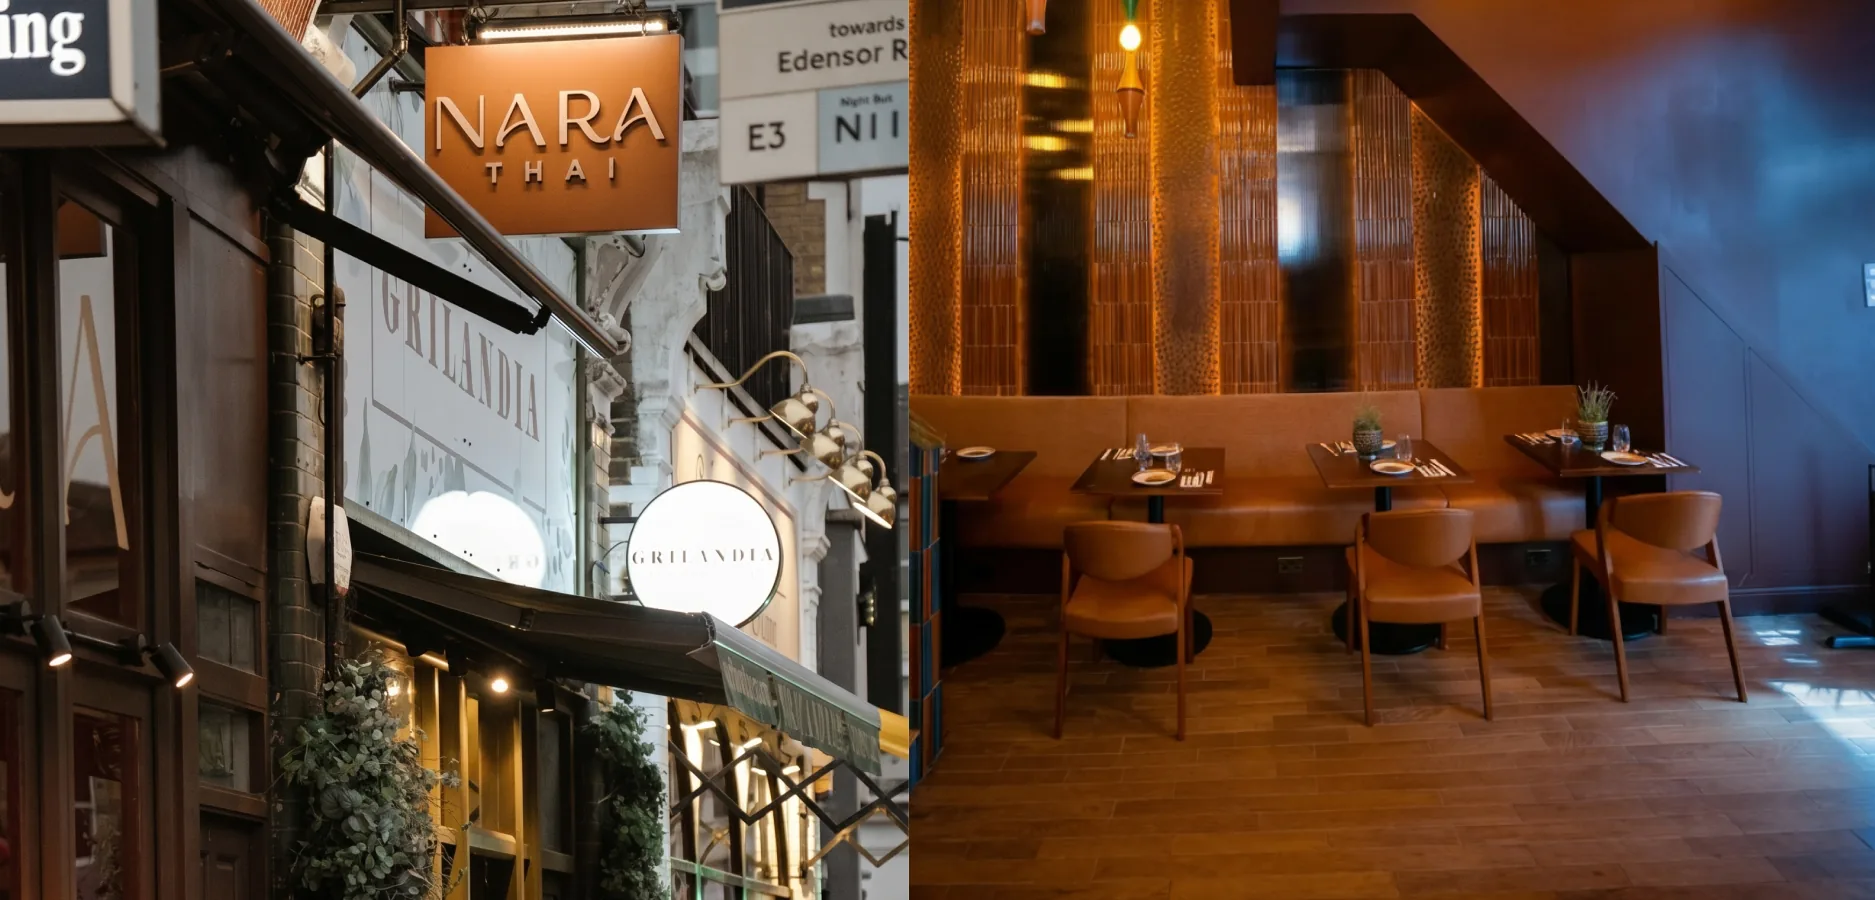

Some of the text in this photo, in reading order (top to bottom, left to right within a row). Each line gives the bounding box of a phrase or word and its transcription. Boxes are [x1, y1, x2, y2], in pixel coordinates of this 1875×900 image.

[829, 15, 905, 38] towards
[778, 46, 884, 74] Edensor
[436, 87, 665, 150] NARA
[748, 120, 786, 151] E3
[485, 156, 615, 184] THAI
[382, 271, 540, 442] GRILANDIA
[632, 547, 774, 565] GRILANDIA
